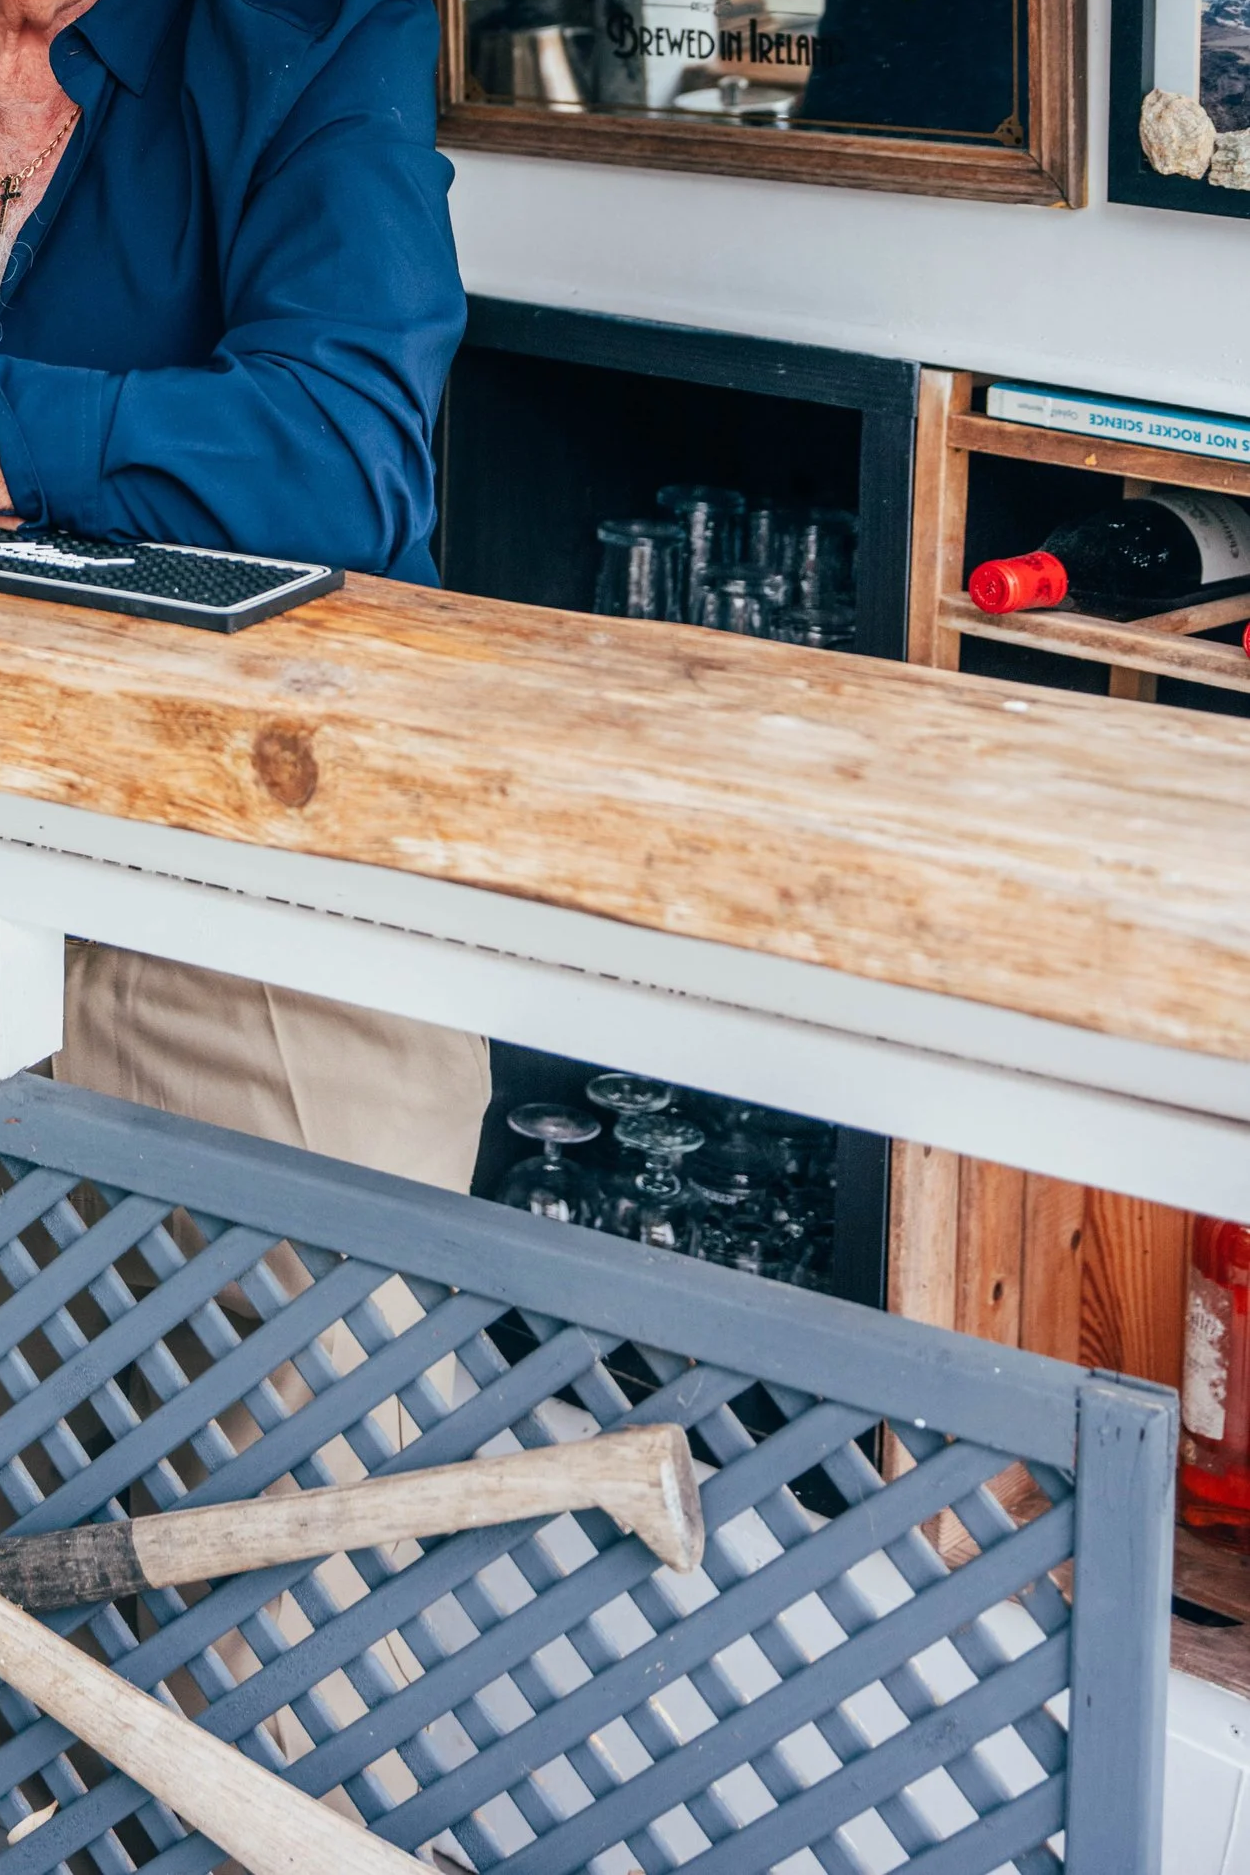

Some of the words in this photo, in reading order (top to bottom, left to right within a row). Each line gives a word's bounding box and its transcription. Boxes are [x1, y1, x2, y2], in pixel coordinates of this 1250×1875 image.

[606, 11, 715, 61] BREWED
[719, 29, 742, 63] IN
[1089, 412, 1143, 434] SCIENCE
[1148, 422, 1201, 443] ROCKET
[1206, 433, 1238, 450] NOT
